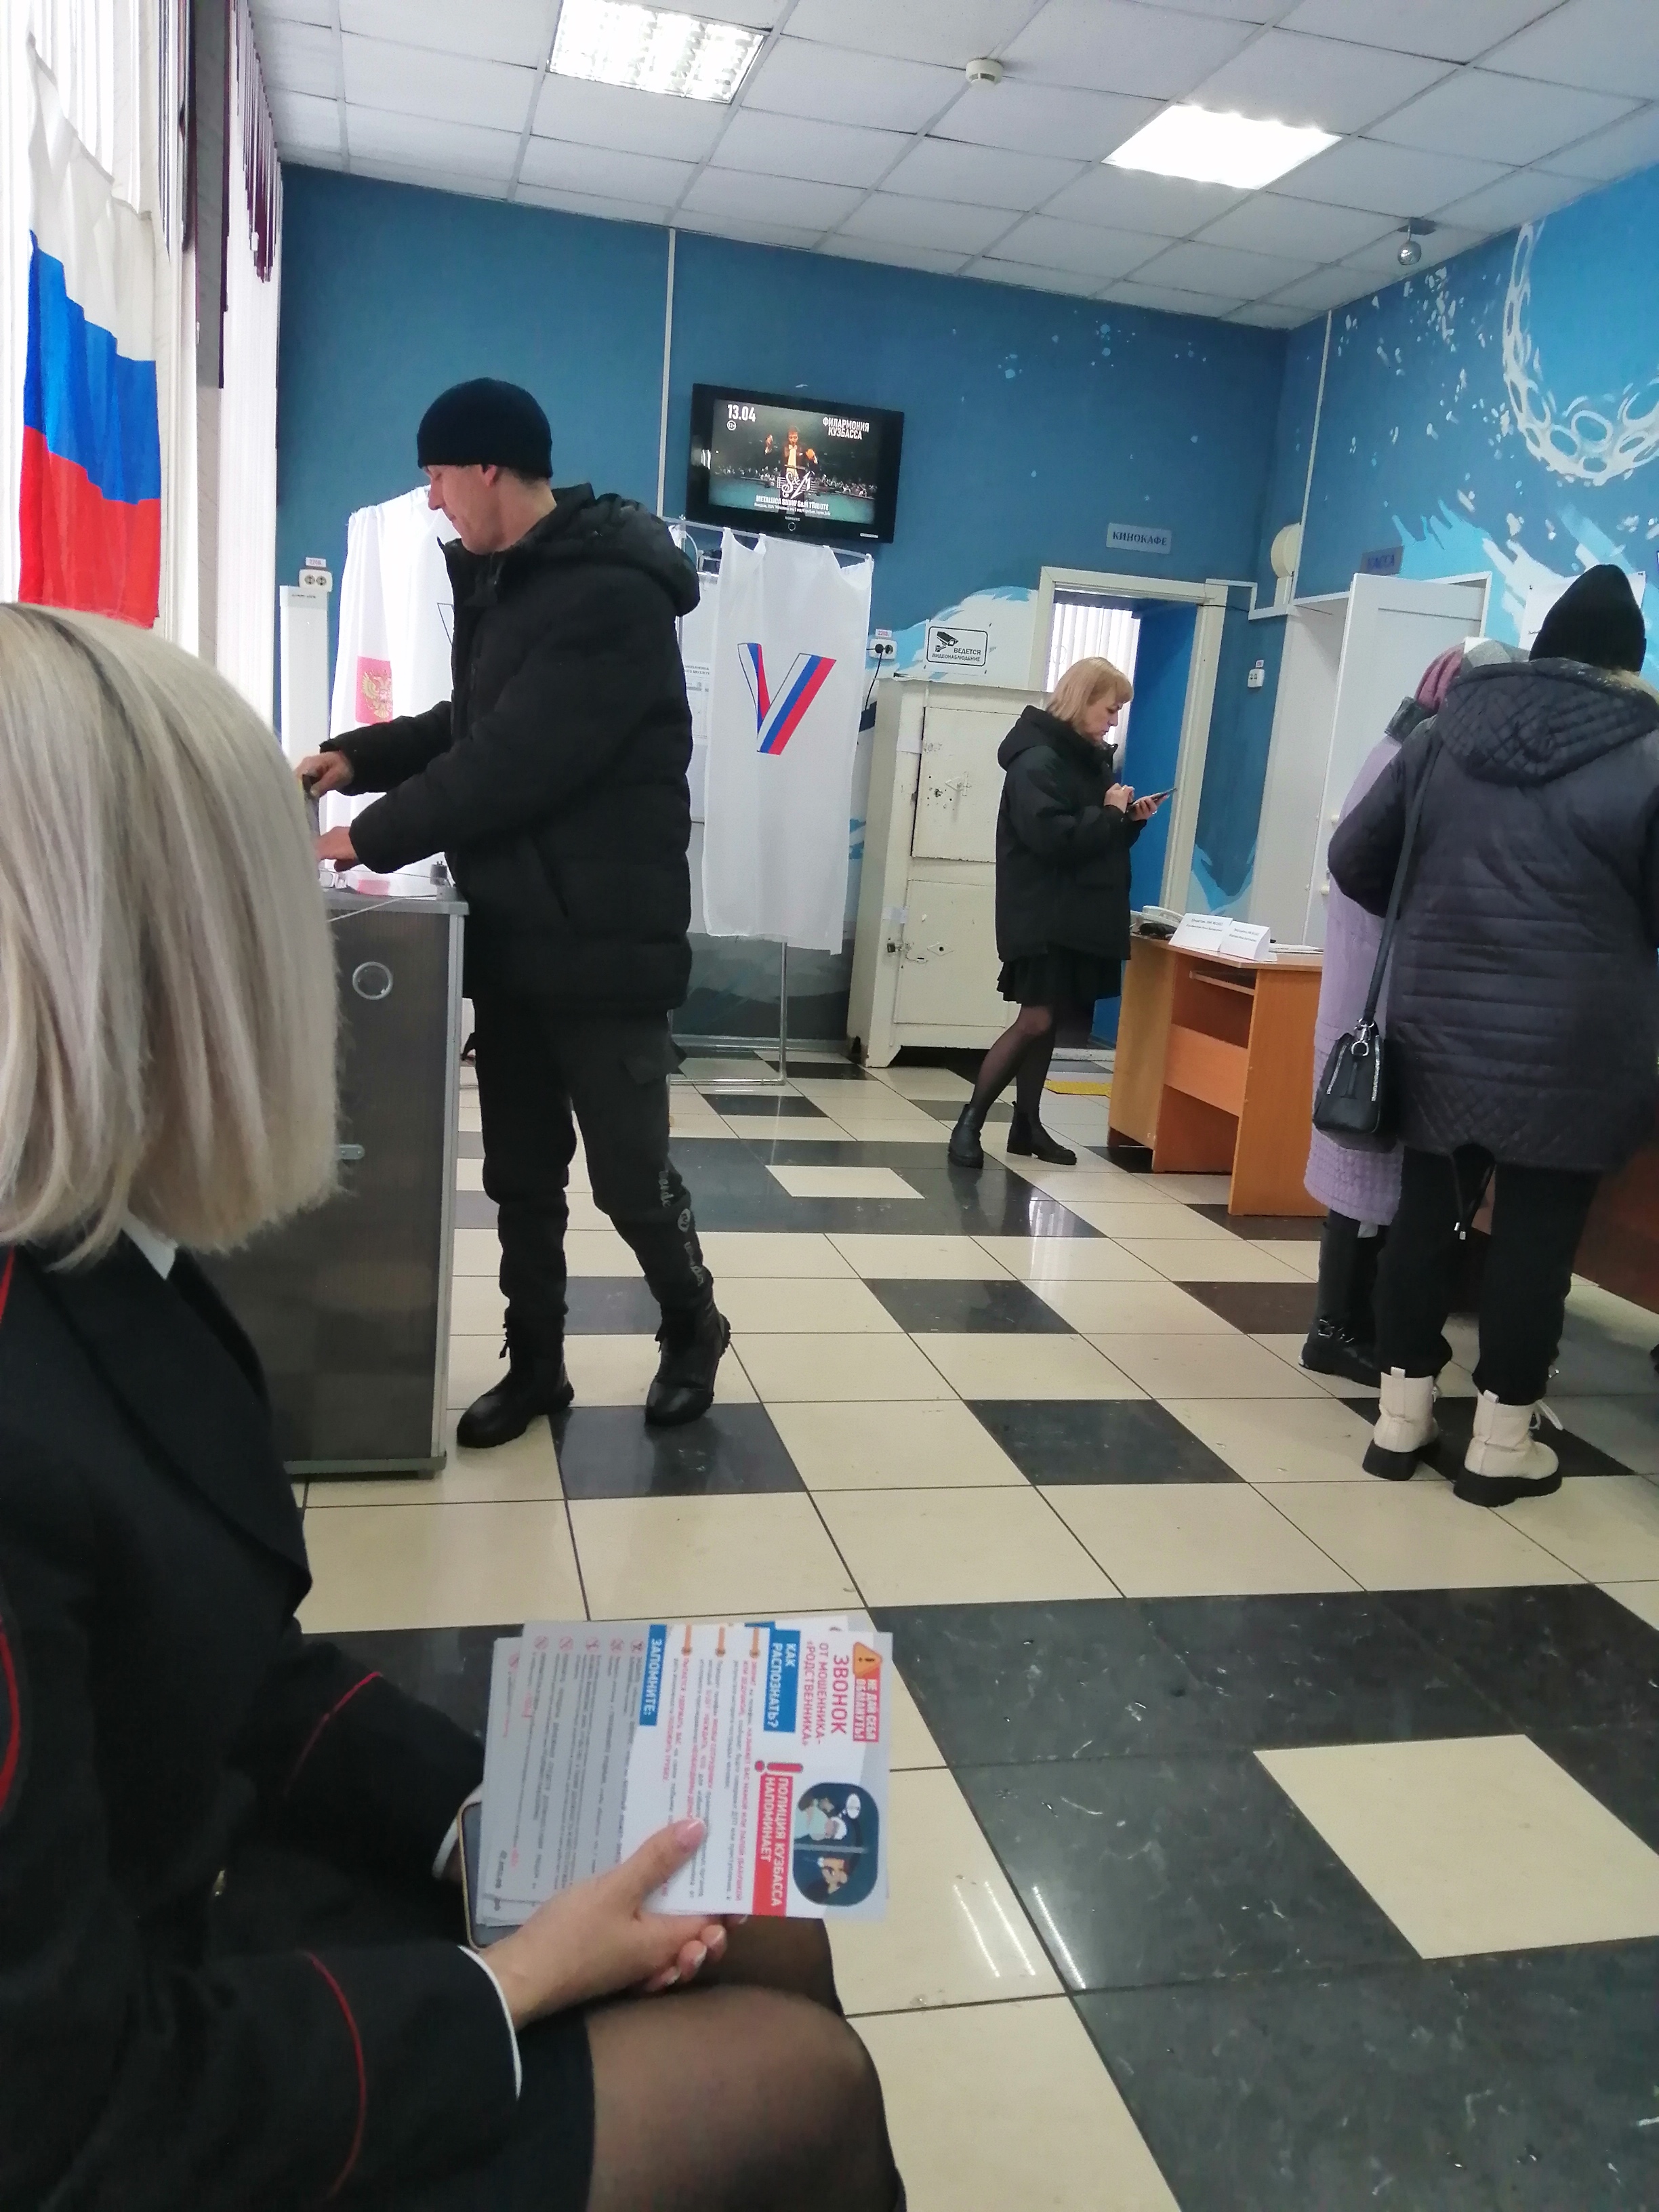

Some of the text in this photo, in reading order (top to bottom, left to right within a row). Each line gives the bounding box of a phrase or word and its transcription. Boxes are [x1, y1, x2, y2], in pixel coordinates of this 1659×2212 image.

[727, 404, 756, 422] 13.04
[822, 416, 869, 433] ФИЛАРМОНИЯ
[827, 426, 863, 440] КУЗБАССА
[1113, 531, 1167, 546] КИНОКАФЕ
[932, 653, 981, 662] ВИДЕОНАБЛЮДЕНИЕ
[954, 647, 981, 655] ВЕДЕТСЯ
[643, 1638, 662, 1716] ЗАПОМНИТЕ:
[785, 1643, 796, 1666] КАК
[767, 1643, 782, 1727] РАСПОЗНАТЬ?
[802, 1641, 815, 1745] «РОДСТВЕННИКА»
[815, 1643, 828, 1744] ОТ МОШЕННИКА-
[832, 1655, 848, 1734] ЗВОНОК
[854, 1679, 865, 1739] ОБМАНУТЬ!
[865, 1679, 879, 1740] НЕ ДАЙ СЕБЯ
[760, 1776, 775, 1862] НАПОМИНАЕТ
[771, 1777, 787, 1906] ПОЛИЦИЯ КУЗБАССА
